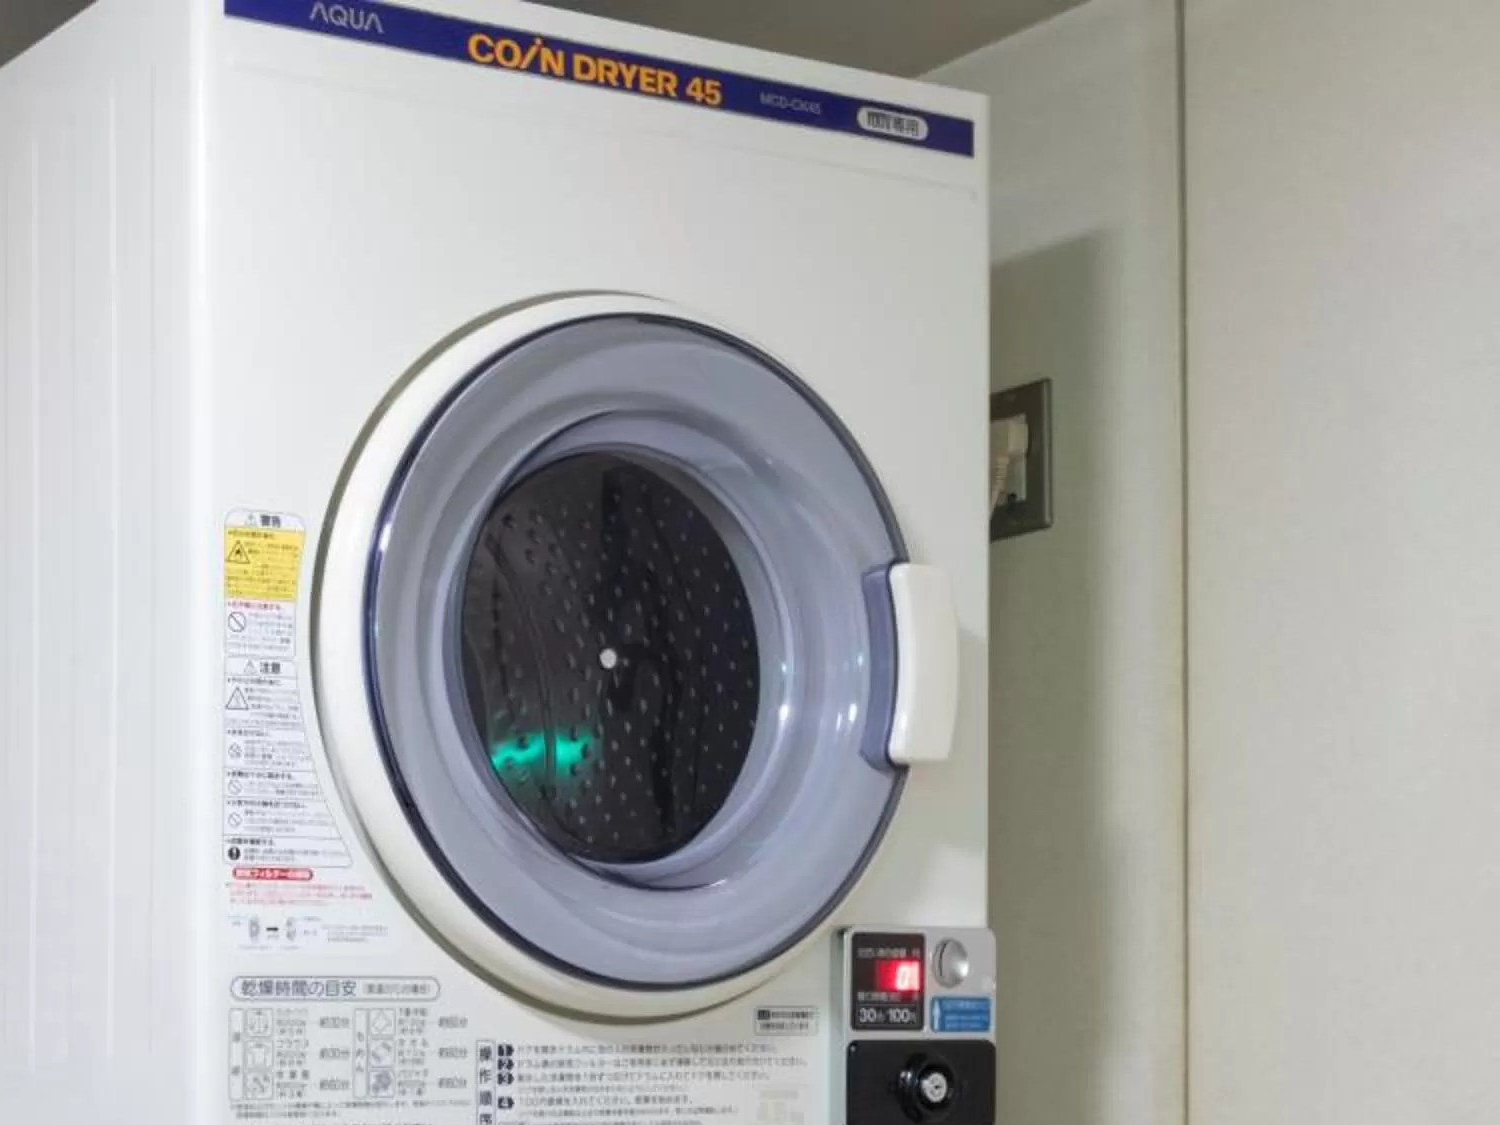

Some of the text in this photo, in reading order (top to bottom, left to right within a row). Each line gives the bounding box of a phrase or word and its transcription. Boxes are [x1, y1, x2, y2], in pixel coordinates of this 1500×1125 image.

[309, 1, 384, 33] AQUA
[573, 54, 678, 98] DRYER
[685, 76, 722, 106] 45
